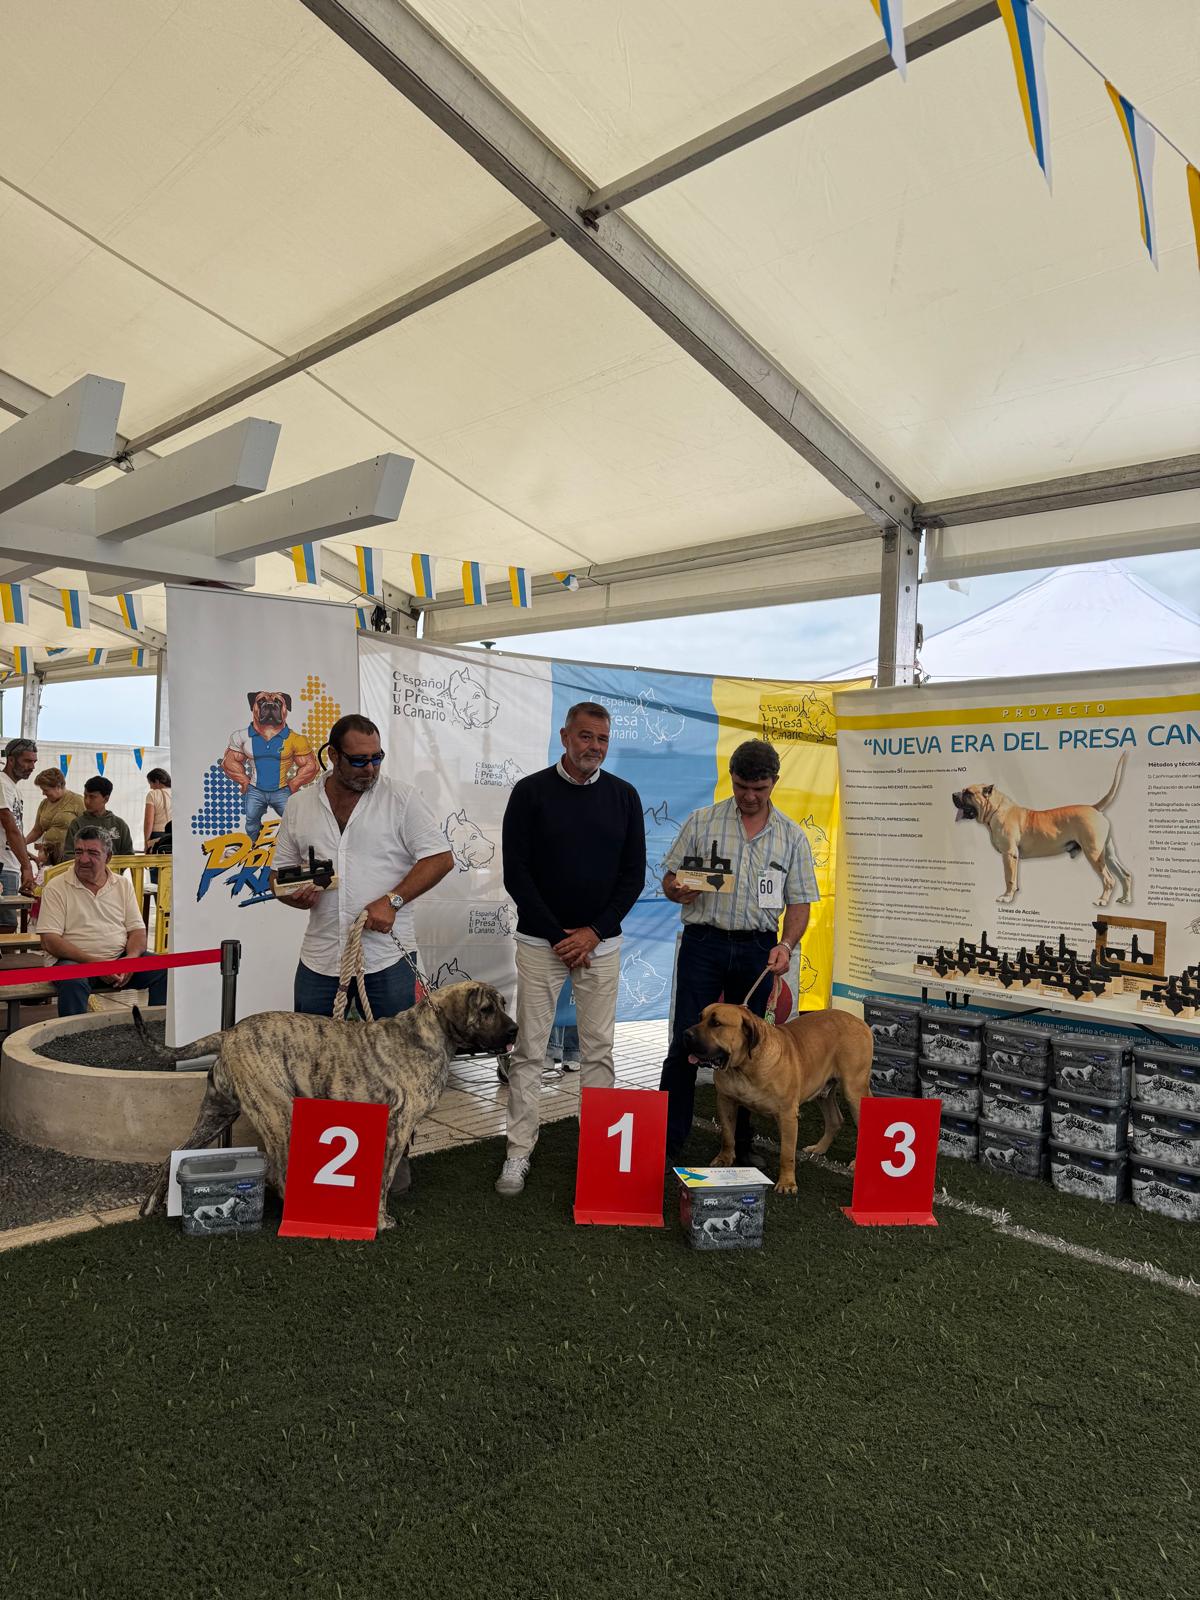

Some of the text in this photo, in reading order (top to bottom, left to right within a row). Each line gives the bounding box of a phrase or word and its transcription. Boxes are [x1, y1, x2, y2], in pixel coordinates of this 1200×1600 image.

[402, 673, 446, 690] Español
[404, 688, 444, 708] Presa
[600, 695, 638, 708] Español
[403, 703, 447, 722] Canario
[767, 702, 801, 714] Español
[1002, 703, 1105, 718] PROYECTO
[610, 714, 638, 726] resa
[771, 716, 803, 729] Presa
[771, 729, 804, 741] Canario
[951, 733, 995, 752] ERA
[1004, 731, 1049, 751] DEL
[1059, 727, 1137, 750] PRESA
[1147, 723, 1200, 746] CAN
[480, 771, 503, 779] Presa
[760, 879, 773, 895] 60
[1055, 1022, 1073, 1032] nadie
[1075, 1026, 1093, 1035] ajeno
[607, 1112, 634, 1173] 1
[880, 1121, 917, 1178] 3
[313, 1125, 360, 1188] 2
